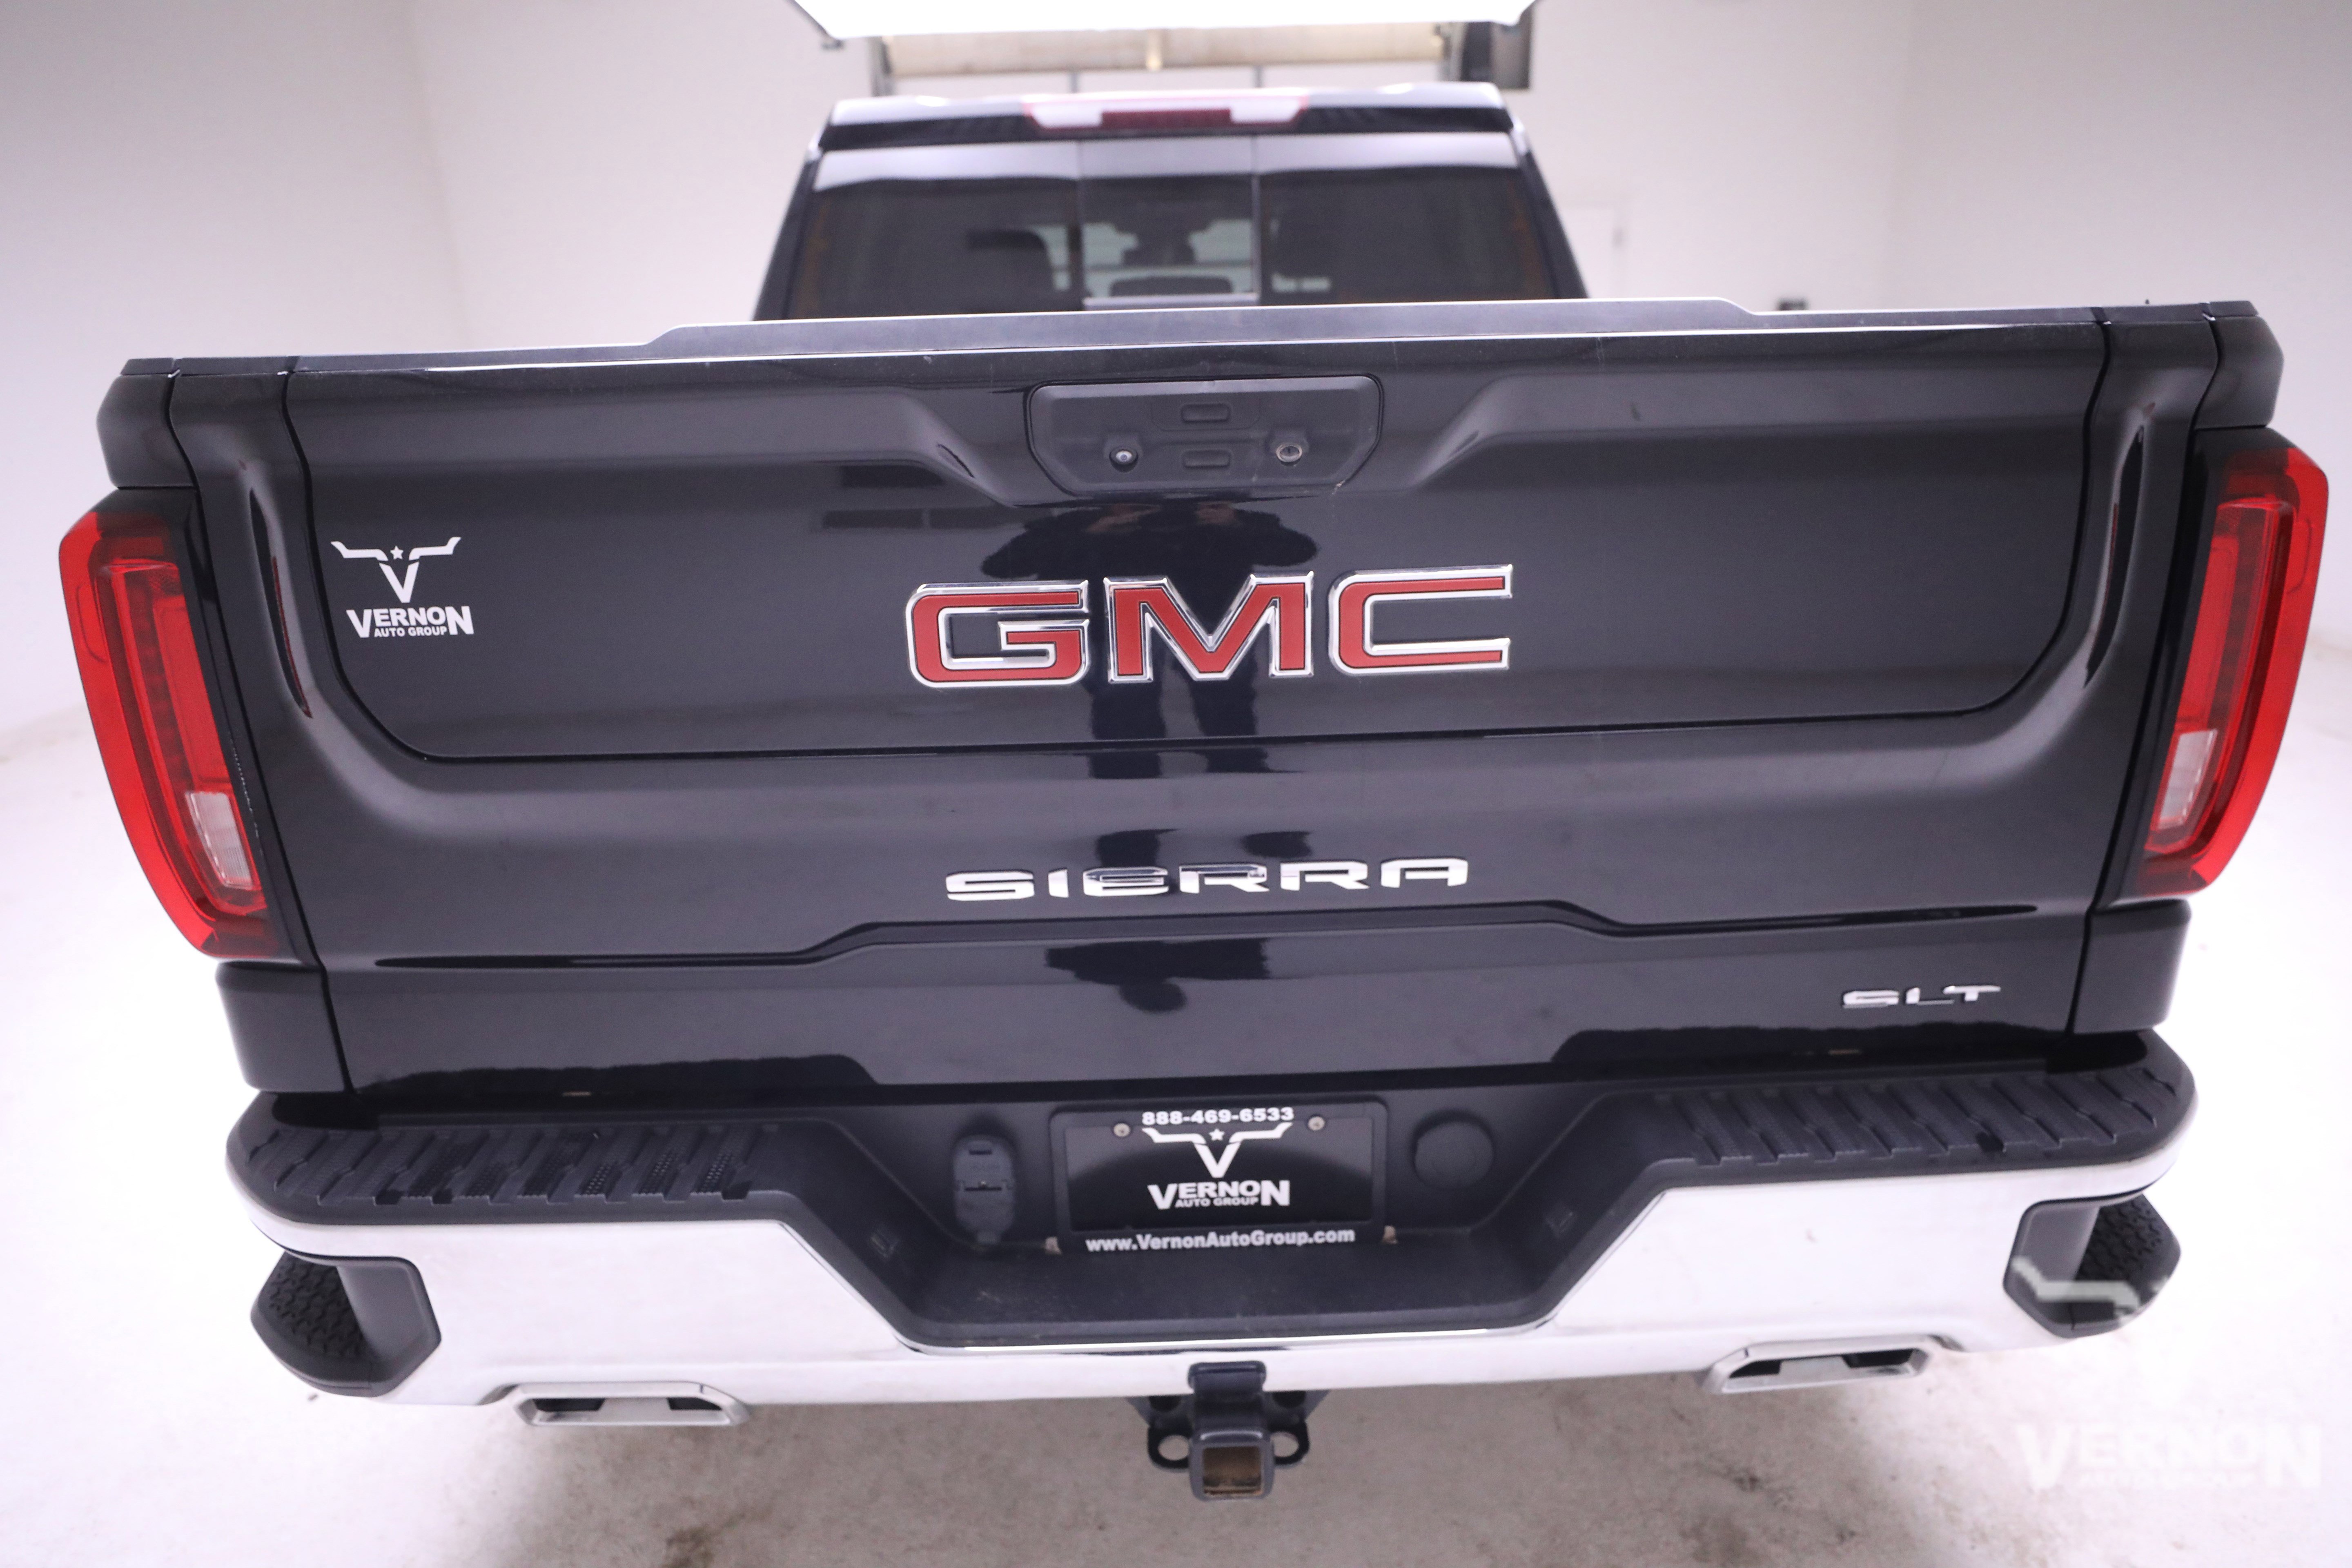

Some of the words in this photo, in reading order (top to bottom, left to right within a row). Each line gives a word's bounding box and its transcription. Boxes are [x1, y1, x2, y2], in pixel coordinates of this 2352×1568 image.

[346, 606, 474, 638] VERNON
[374, 628, 405, 637] AUTO
[408, 626, 448, 636] GROUP
[906, 564, 1513, 687] GMC
[946, 858, 1468, 901] SIERRA
[1843, 985, 2001, 1009] SLT
[1142, 1107, 1294, 1125] 888-469-6533
[1147, 1180, 1290, 1209] VERNON
[1175, 1198, 1210, 1208] AUTO
[1213, 1197, 1259, 1206] GROUP
[1086, 1229, 1355, 1252] www.VernonAutoGroup.com
